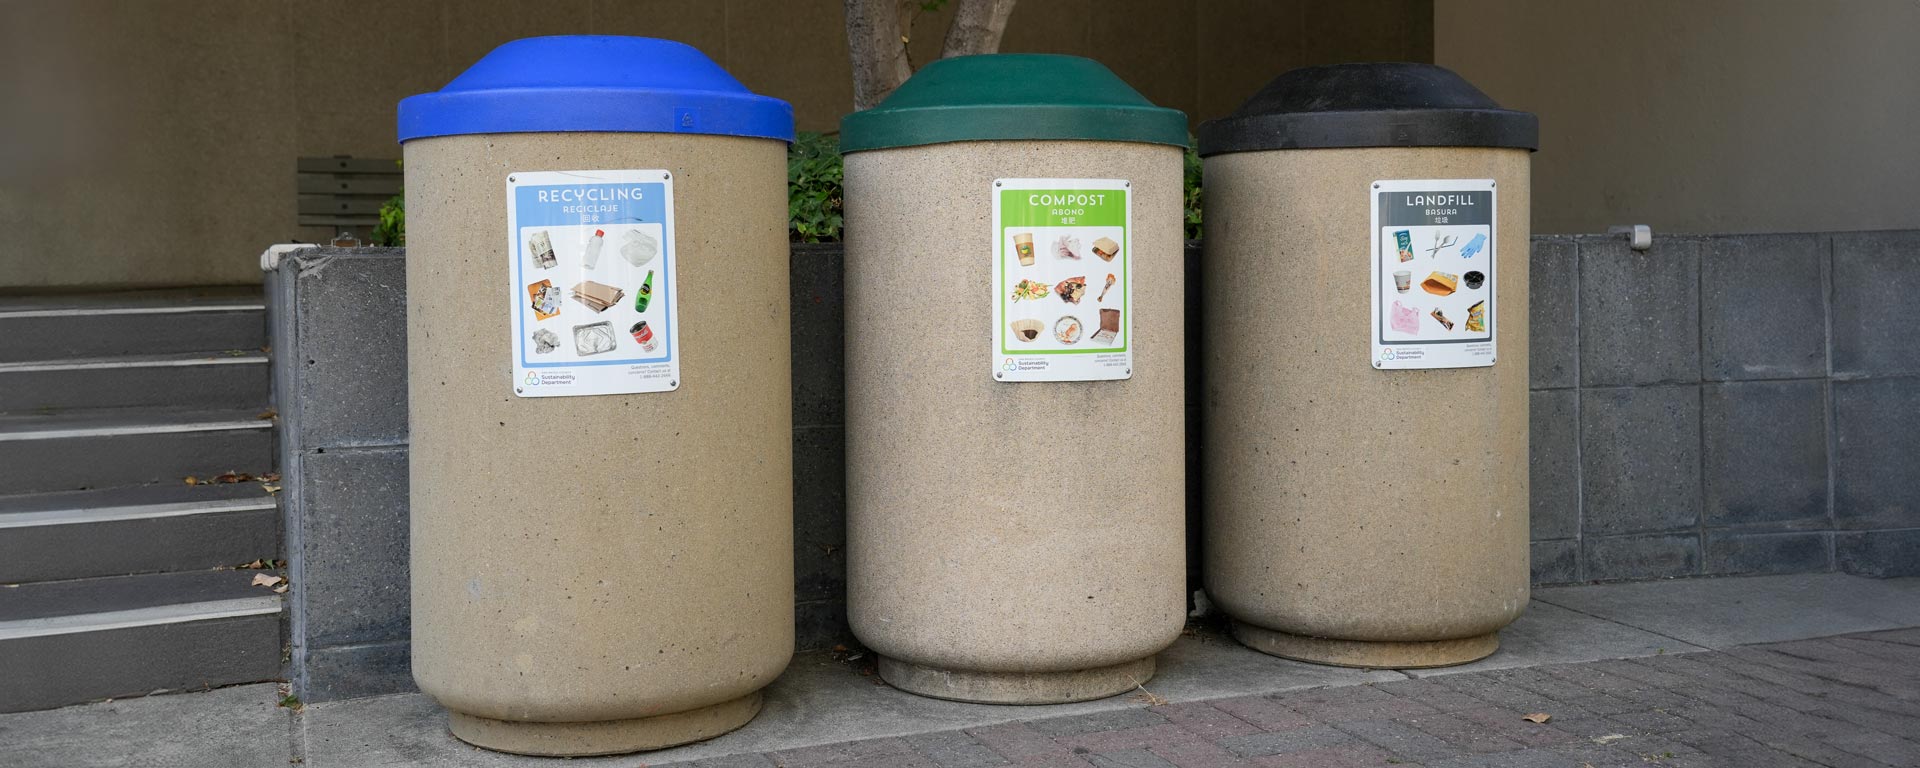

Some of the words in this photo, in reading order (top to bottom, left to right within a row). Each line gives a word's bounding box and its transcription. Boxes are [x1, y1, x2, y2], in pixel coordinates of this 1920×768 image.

[538, 188, 643, 203] RECYCLING
[1029, 194, 1105, 206] COMPOST
[1406, 194, 1475, 206] LANDFILL
[563, 204, 619, 213] RECICLAJE
[1052, 208, 1085, 216] ABONO
[1425, 208, 1457, 216] BASURA
